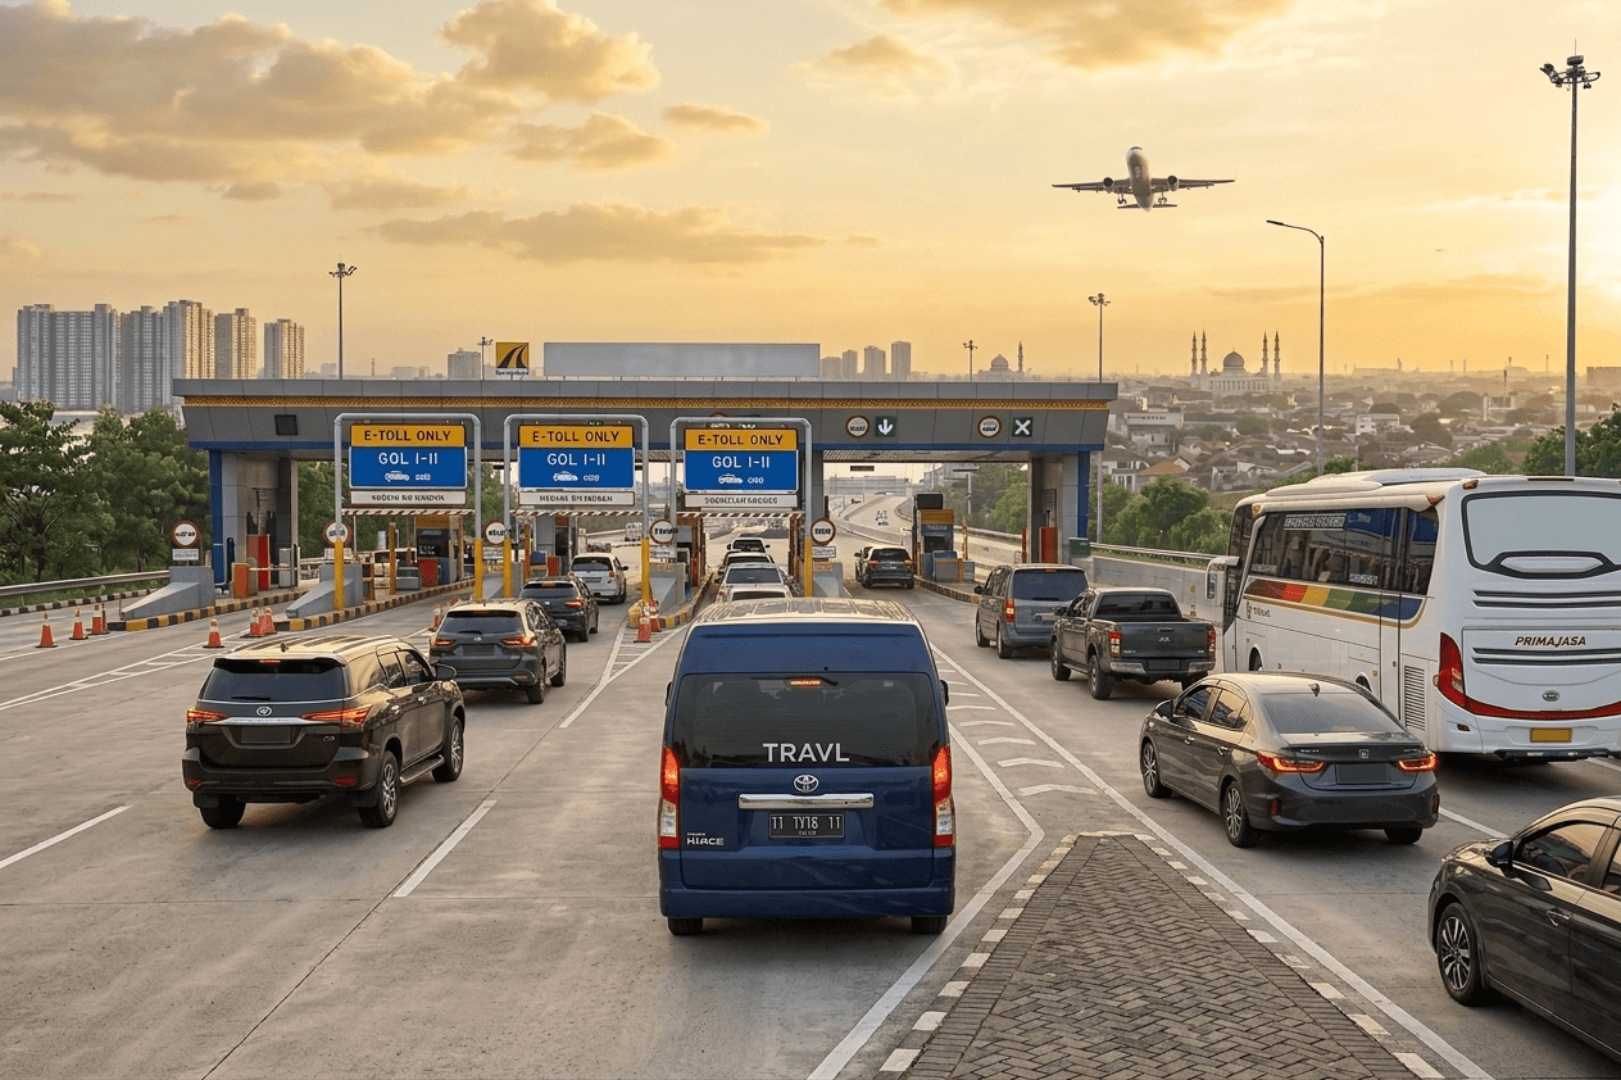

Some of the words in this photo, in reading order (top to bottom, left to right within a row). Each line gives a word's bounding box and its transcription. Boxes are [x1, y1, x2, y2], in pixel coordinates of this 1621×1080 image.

[364, 430, 411, 441] E-TOLL
[416, 430, 451, 441] ONLY
[532, 431, 580, 442] E-TOLL
[585, 431, 620, 442] ONLY
[698, 434, 744, 445] E-TOLL
[750, 434, 784, 445] ONLY
[378, 452, 409, 465] GOL
[547, 453, 577, 466] GOL
[712, 456, 742, 469] GOL
[1514, 636, 1586, 648] PRIMAJASA
[762, 742, 850, 763] TRAVL
[686, 837, 725, 846] HIACE
